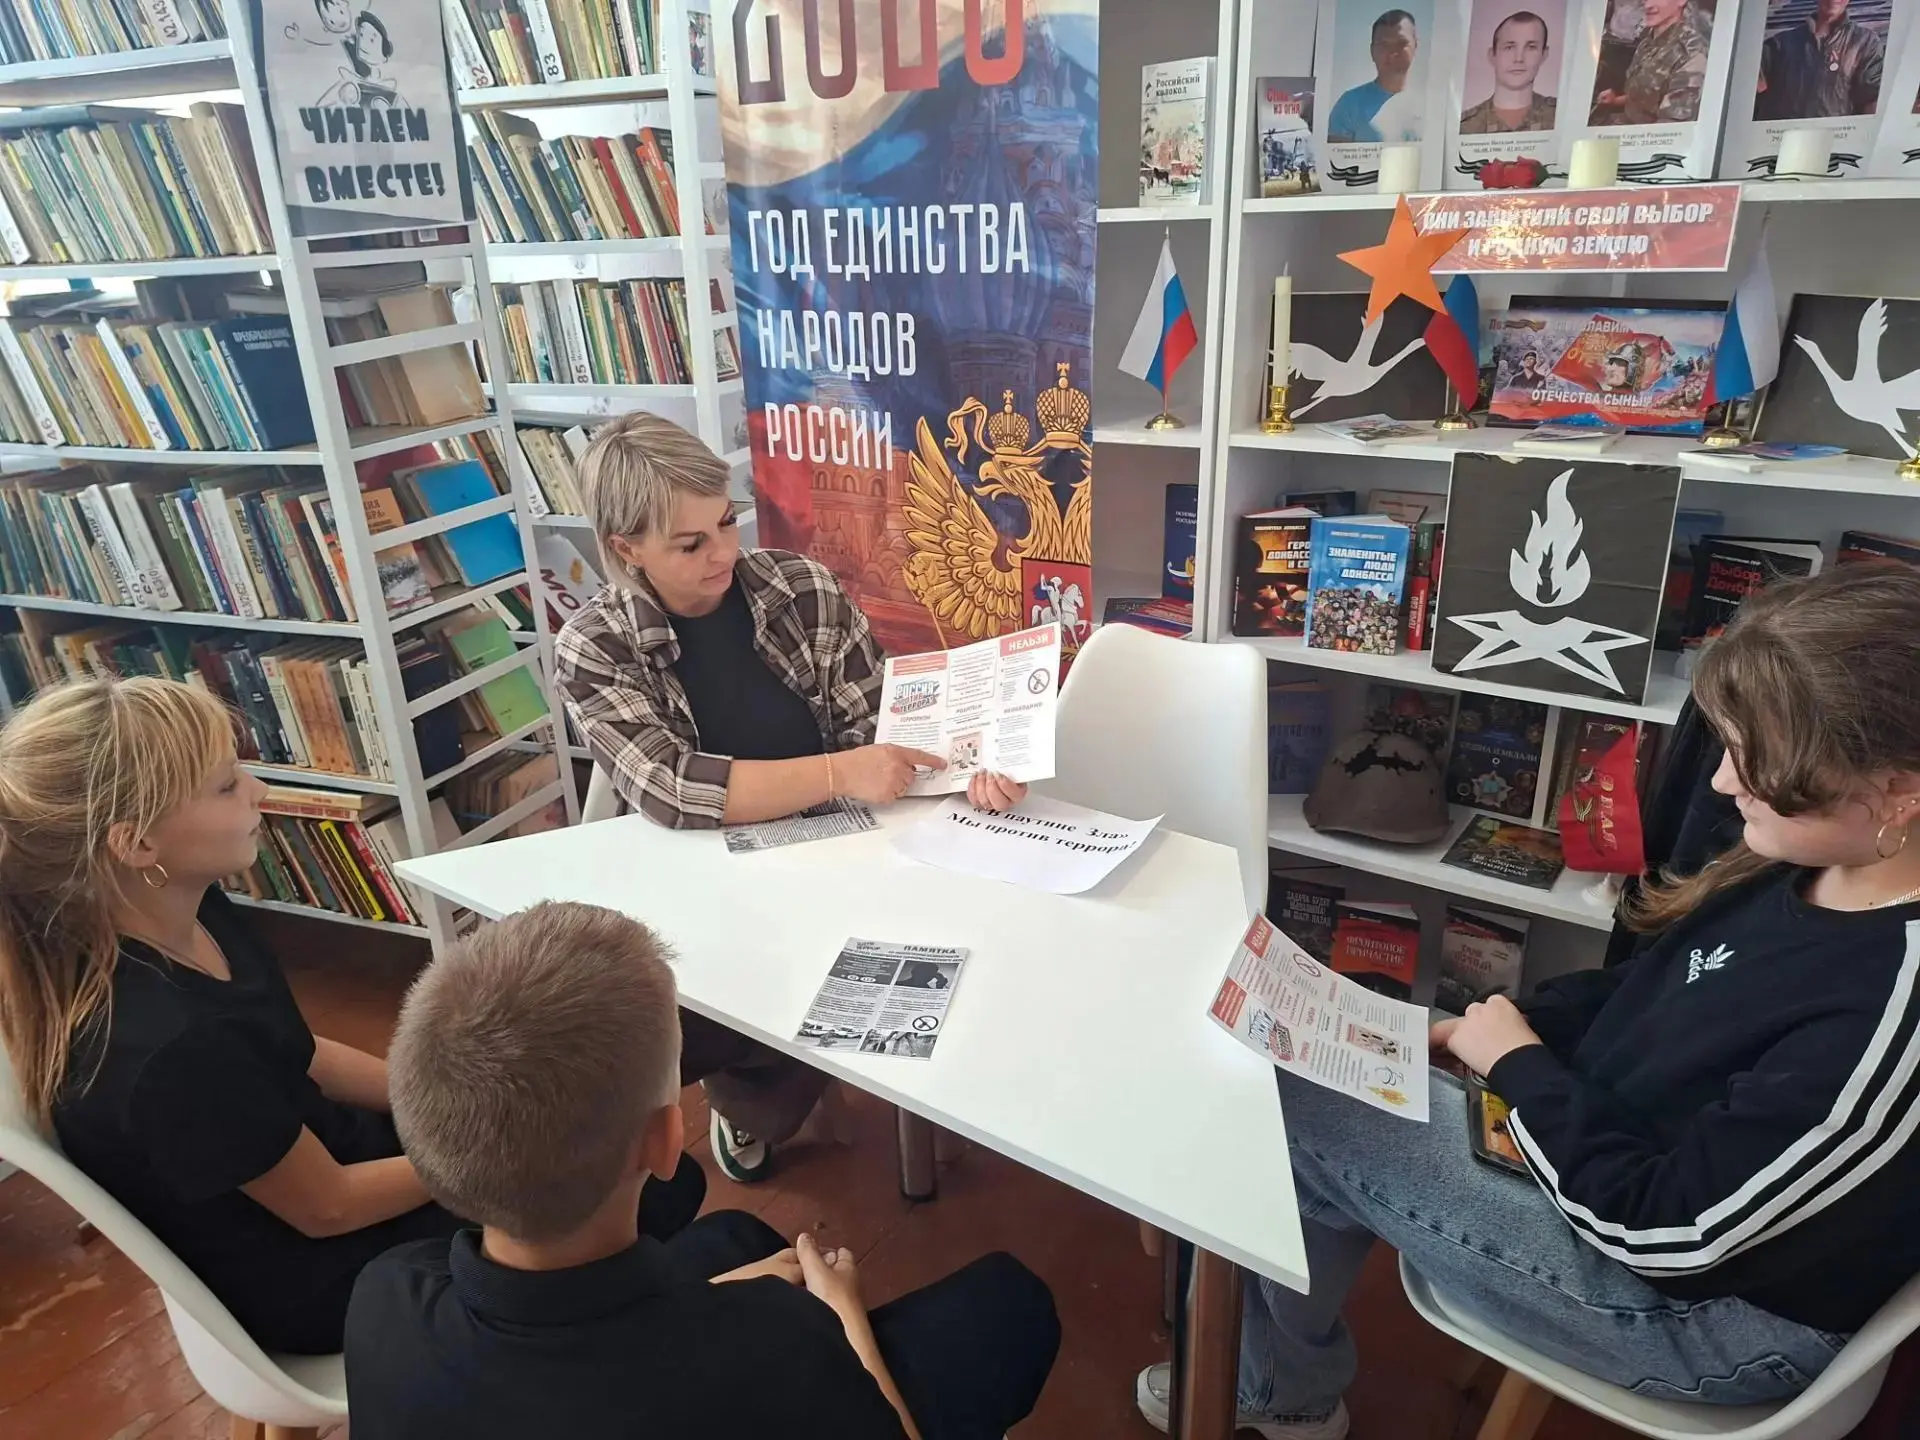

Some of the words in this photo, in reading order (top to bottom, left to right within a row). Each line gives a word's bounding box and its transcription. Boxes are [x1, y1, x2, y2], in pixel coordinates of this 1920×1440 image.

[547, 52, 560, 76] 83
[471, 63, 489, 88] 82
[1156, 74, 1200, 88] Российский
[1155, 87, 1187, 98] колокол
[299, 107, 430, 144] ЧИТАЕМ
[304, 162, 445, 203] ВМЕСТЕ!
[1574, 201, 1628, 225] СВОЙ
[1634, 203, 1713, 223] ВЫБОР
[748, 210, 814, 281] ГОД
[824, 203, 1029, 281] ЕДИНСТВА
[1572, 235, 1649, 255] ЗЕМЛЮ
[757, 310, 916, 381] НАРОДОВ
[577, 364, 589, 384] 85
[1532, 389, 1600, 405] ОТЕЧЕСТВА
[764, 402, 893, 470] РОССИИ
[1287, 541, 1311, 550] ГЕРО
[1328, 548, 1397, 561] ЗНАМЕНИТЫЕ
[1267, 551, 1311, 561] ДОНБАСС
[1341, 569, 1393, 582] ДОНБАССА
[1363, 561, 1395, 572] ЛЮДИ
[1009, 634, 1049, 652] НЕЛЬЗЯ
[947, 812, 980, 828] Мы
[985, 824, 1050, 842] против
[1004, 813, 1077, 832] паутине
[904, 945, 956, 954] ПАМЯТКА
